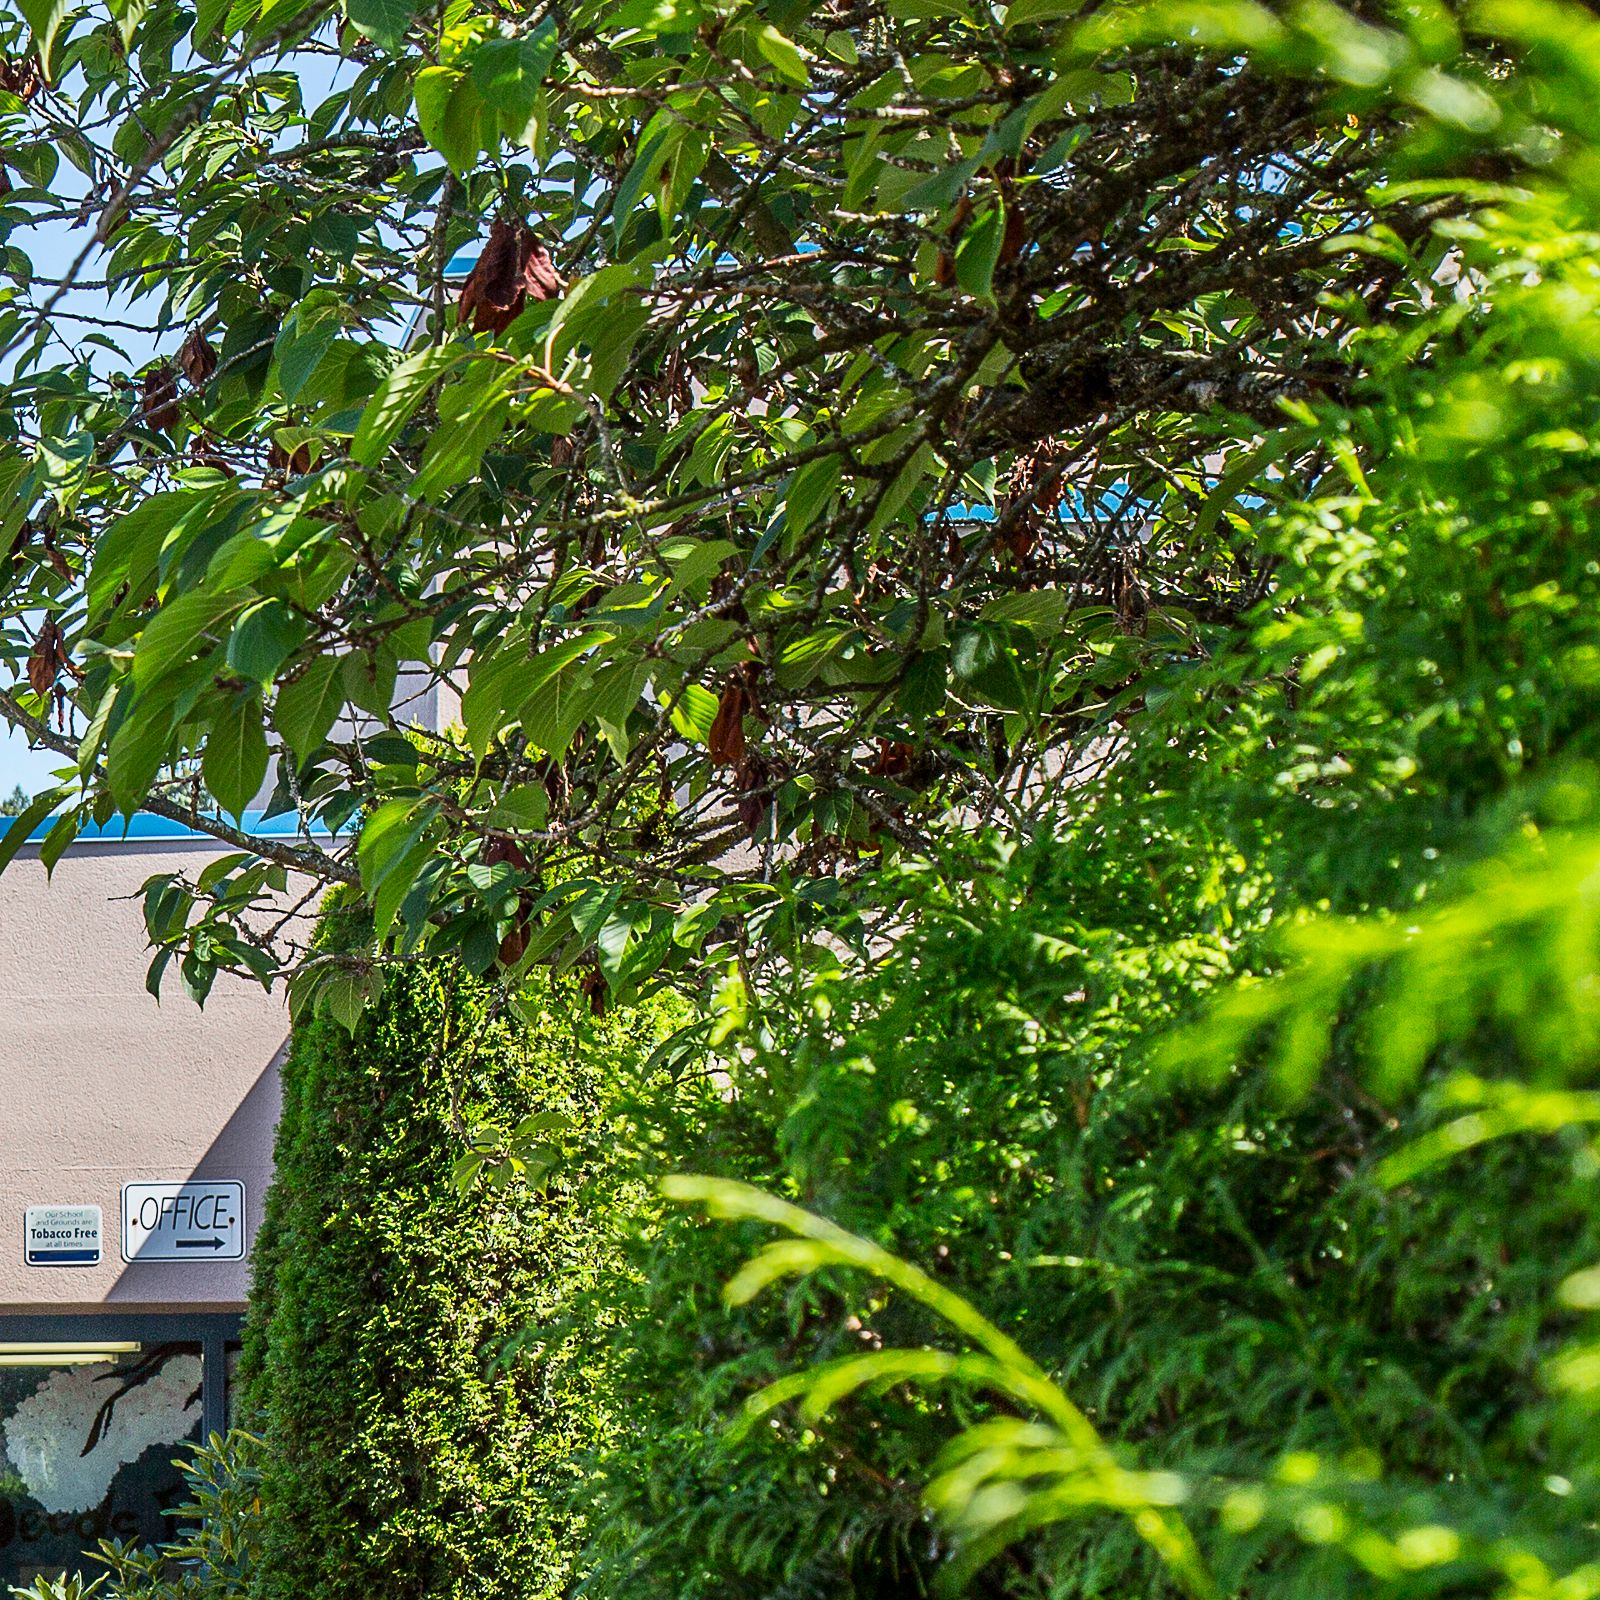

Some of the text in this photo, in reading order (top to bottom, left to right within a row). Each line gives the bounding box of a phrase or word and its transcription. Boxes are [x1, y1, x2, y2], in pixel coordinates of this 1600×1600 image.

[140, 1195, 230, 1230] OFFICE
[31, 1227, 97, 1239] Tobacco Free
